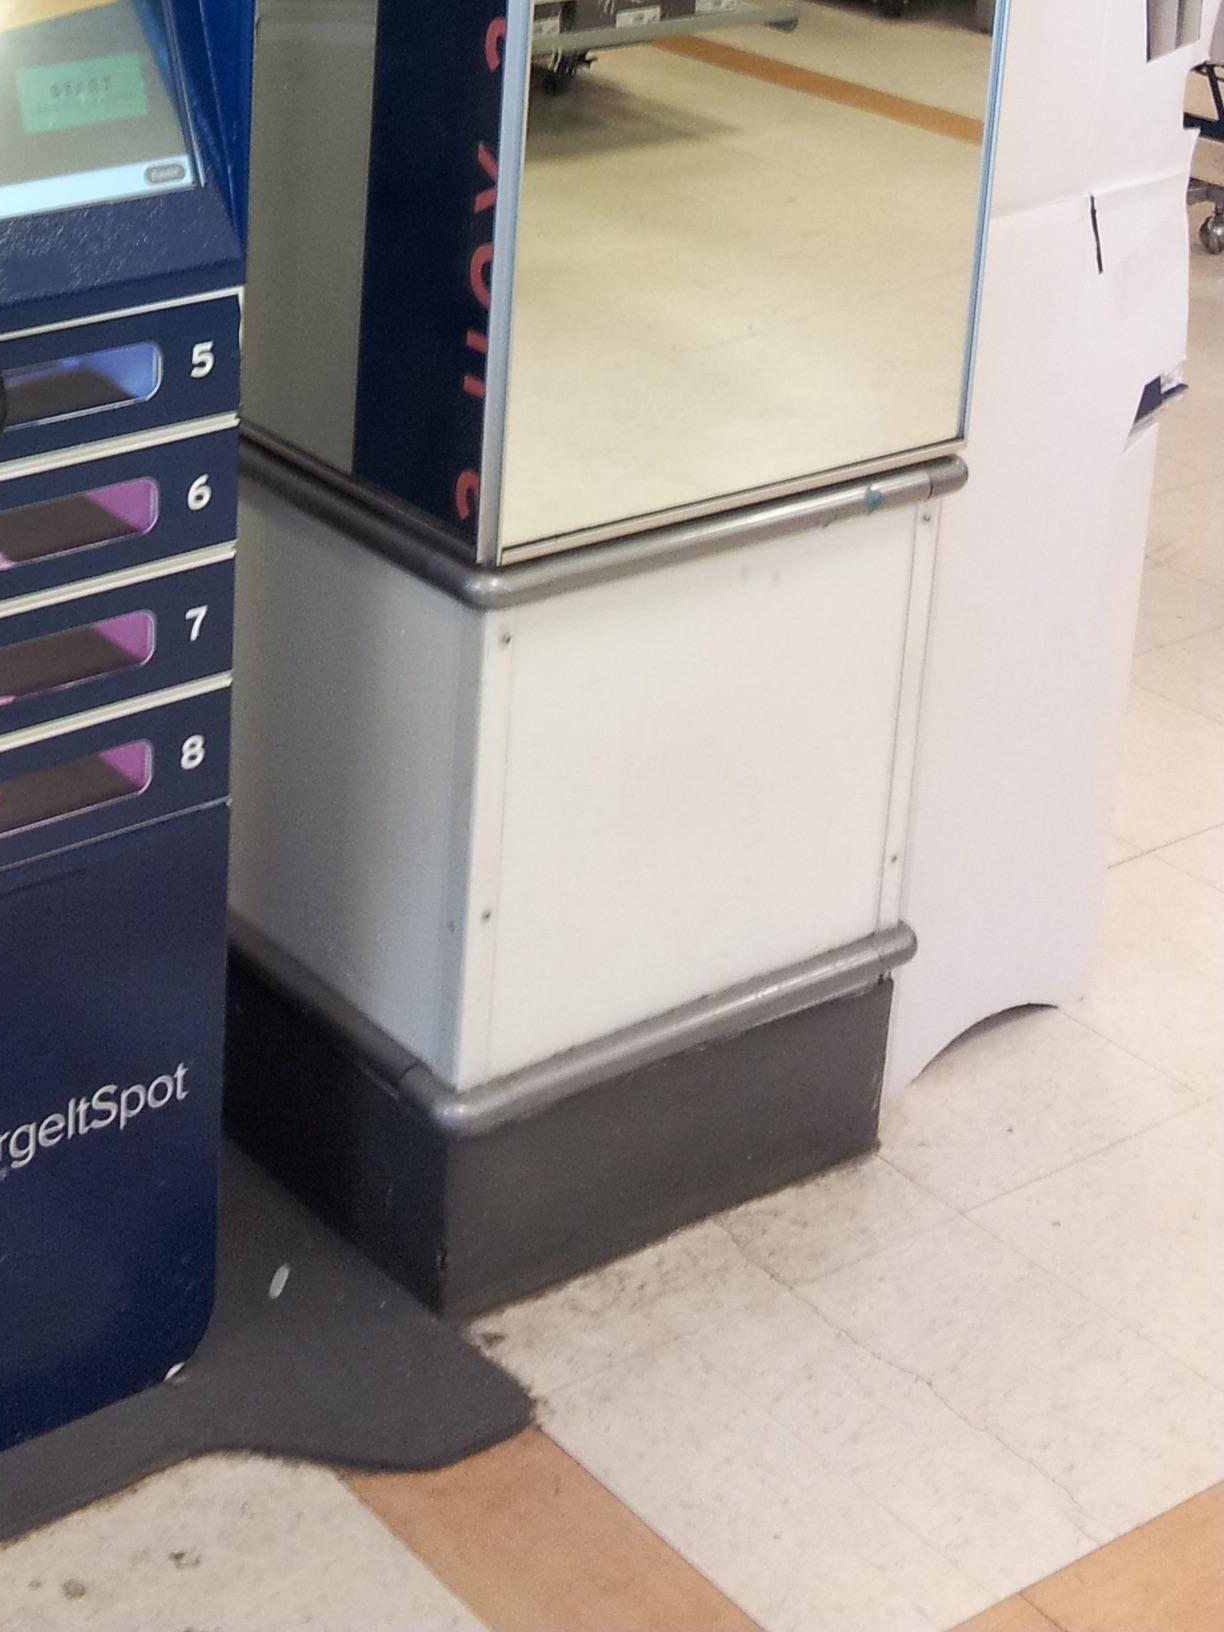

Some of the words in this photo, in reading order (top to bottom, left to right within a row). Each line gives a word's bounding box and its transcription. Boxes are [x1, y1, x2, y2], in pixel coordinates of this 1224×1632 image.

[190, 341, 215, 378] 5
[186, 473, 212, 511] 6
[185, 605, 210, 642] 7
[180, 734, 206, 770] 8
